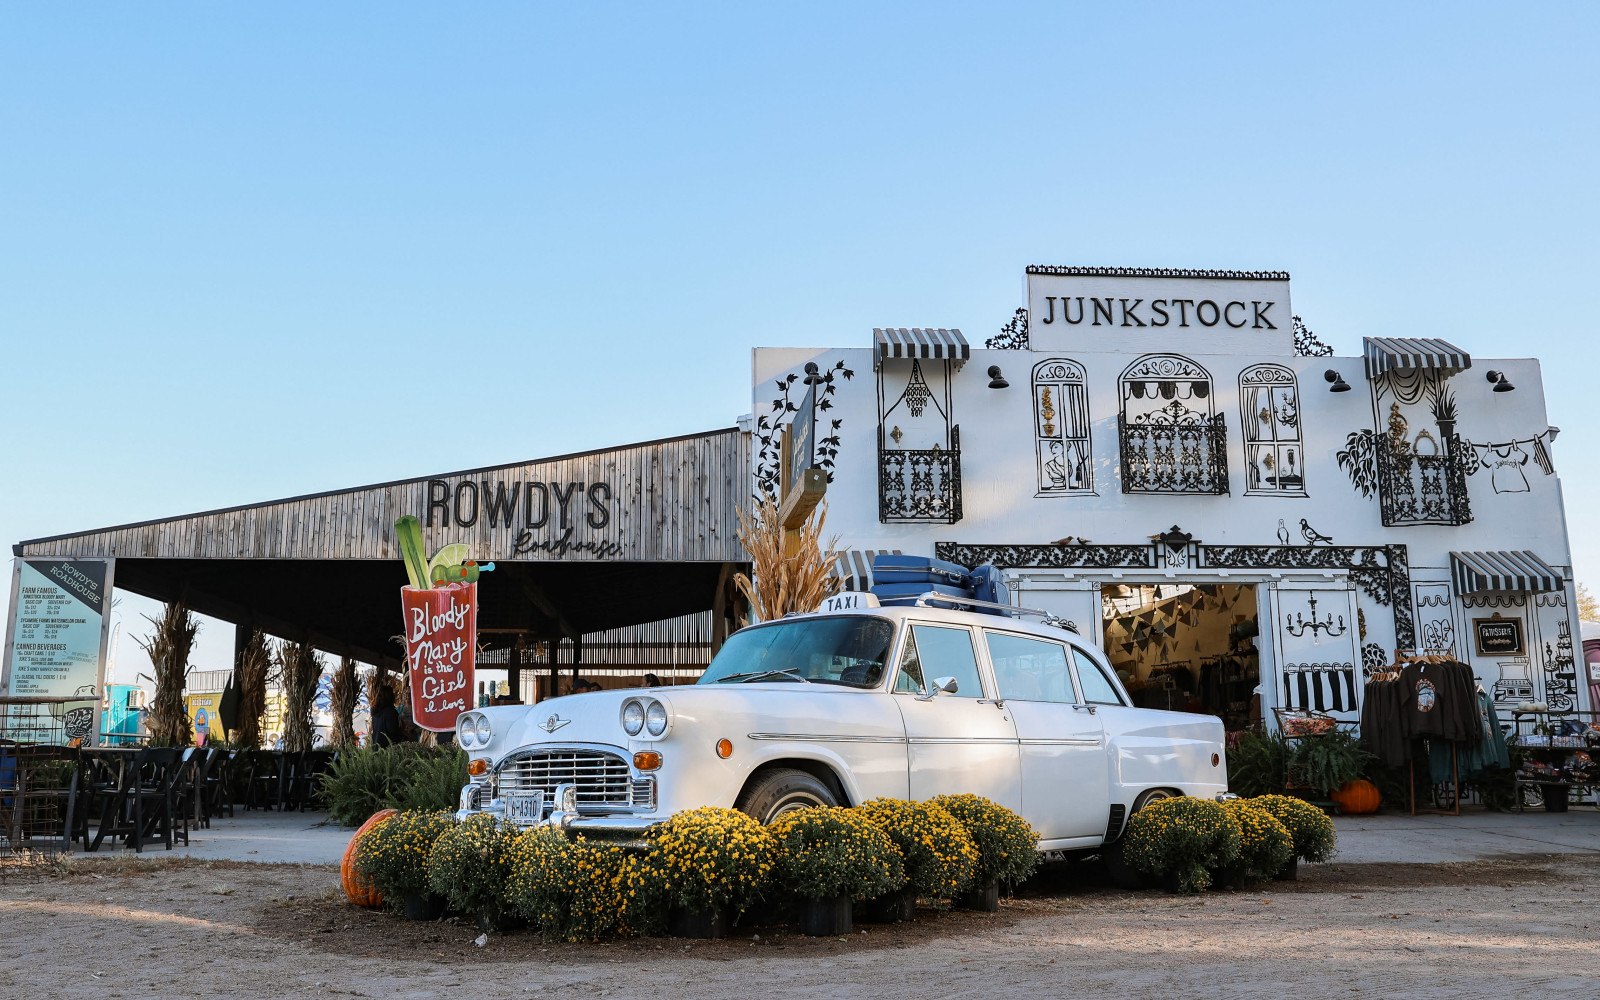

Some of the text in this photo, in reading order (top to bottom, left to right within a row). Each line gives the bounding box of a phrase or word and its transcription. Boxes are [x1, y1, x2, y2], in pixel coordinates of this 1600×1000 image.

[1042, 296, 1278, 330] JUNKSTOCK
[426, 479, 611, 529] ROWDY'S
[512, 526, 622, 560] Roadhouse
[50, 566, 100, 604] ROADHOUSE
[62, 562, 98, 590] ROWDY'S
[828, 596, 858, 611] TAXI
[410, 596, 470, 643] Bloody
[1482, 628, 1512, 636] PATISSERIE
[411, 636, 468, 670] Mary
[424, 661, 453, 674] is the
[421, 670, 466, 699] Girl
[439, 698, 464, 712] love
[511, 800, 537, 816] 6-A310
